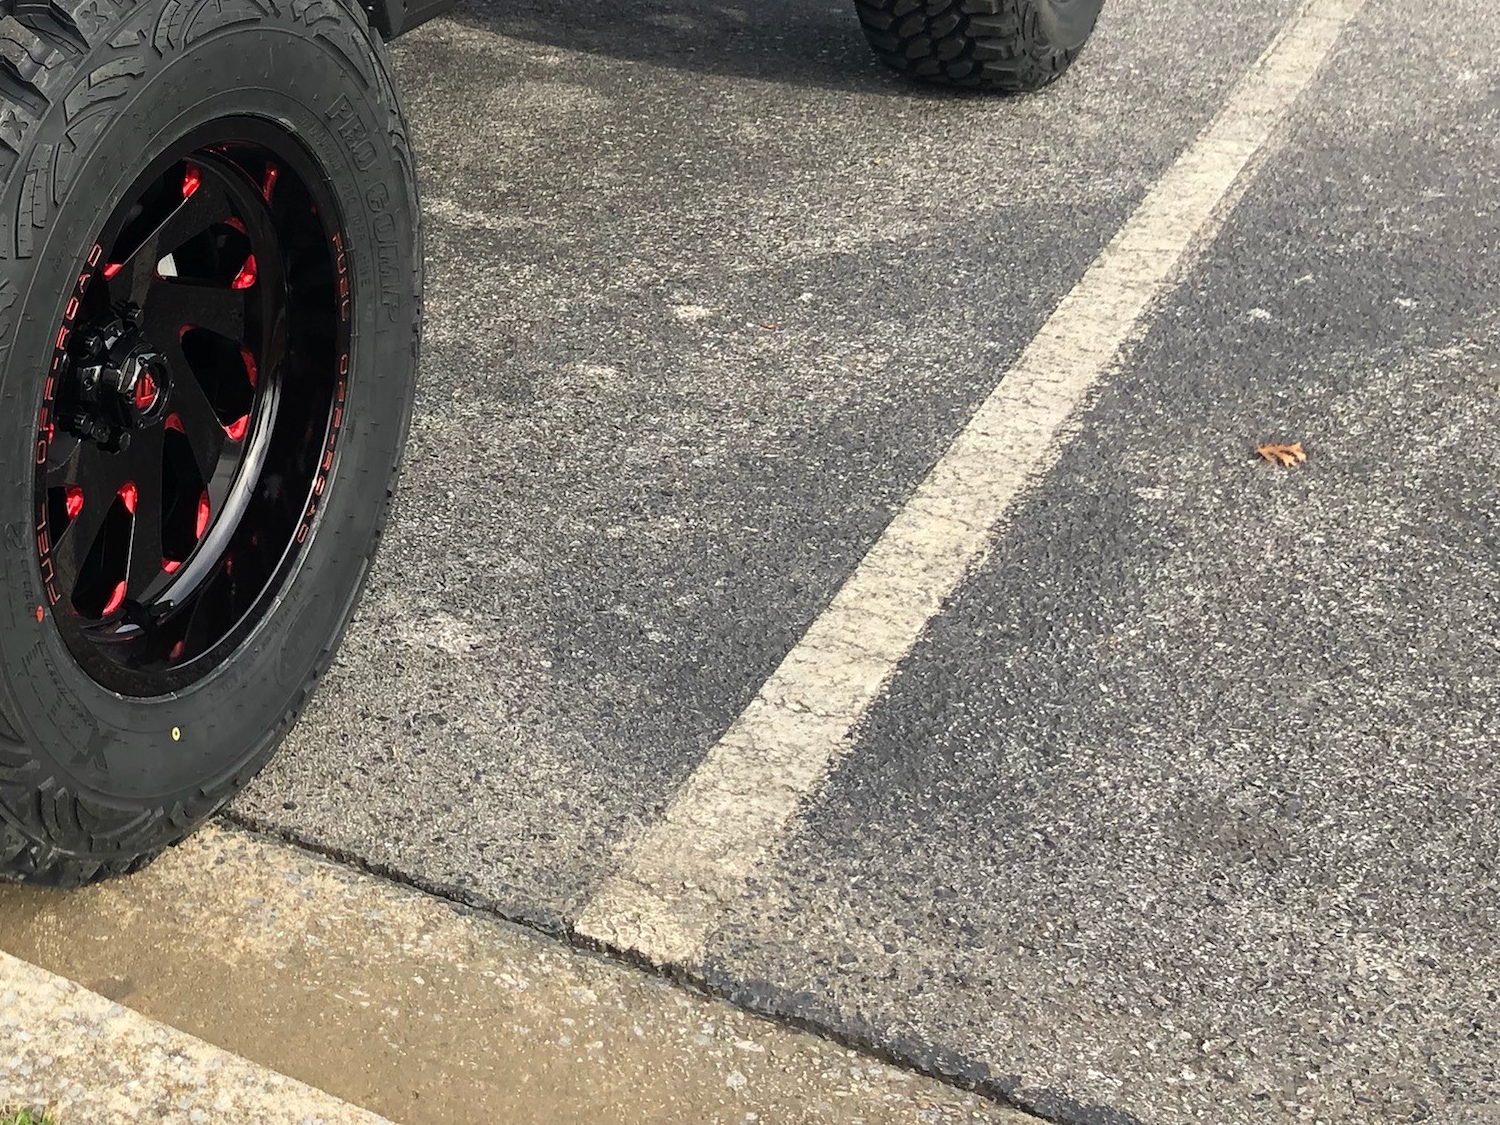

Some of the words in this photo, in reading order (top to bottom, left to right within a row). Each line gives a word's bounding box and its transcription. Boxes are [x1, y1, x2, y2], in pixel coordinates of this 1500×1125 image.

[325, 92, 378, 172] PRO
[366, 182, 401, 323] COMP
[37, 243, 102, 464] OFF-ROAD
[36, 502, 61, 606] FUEL
